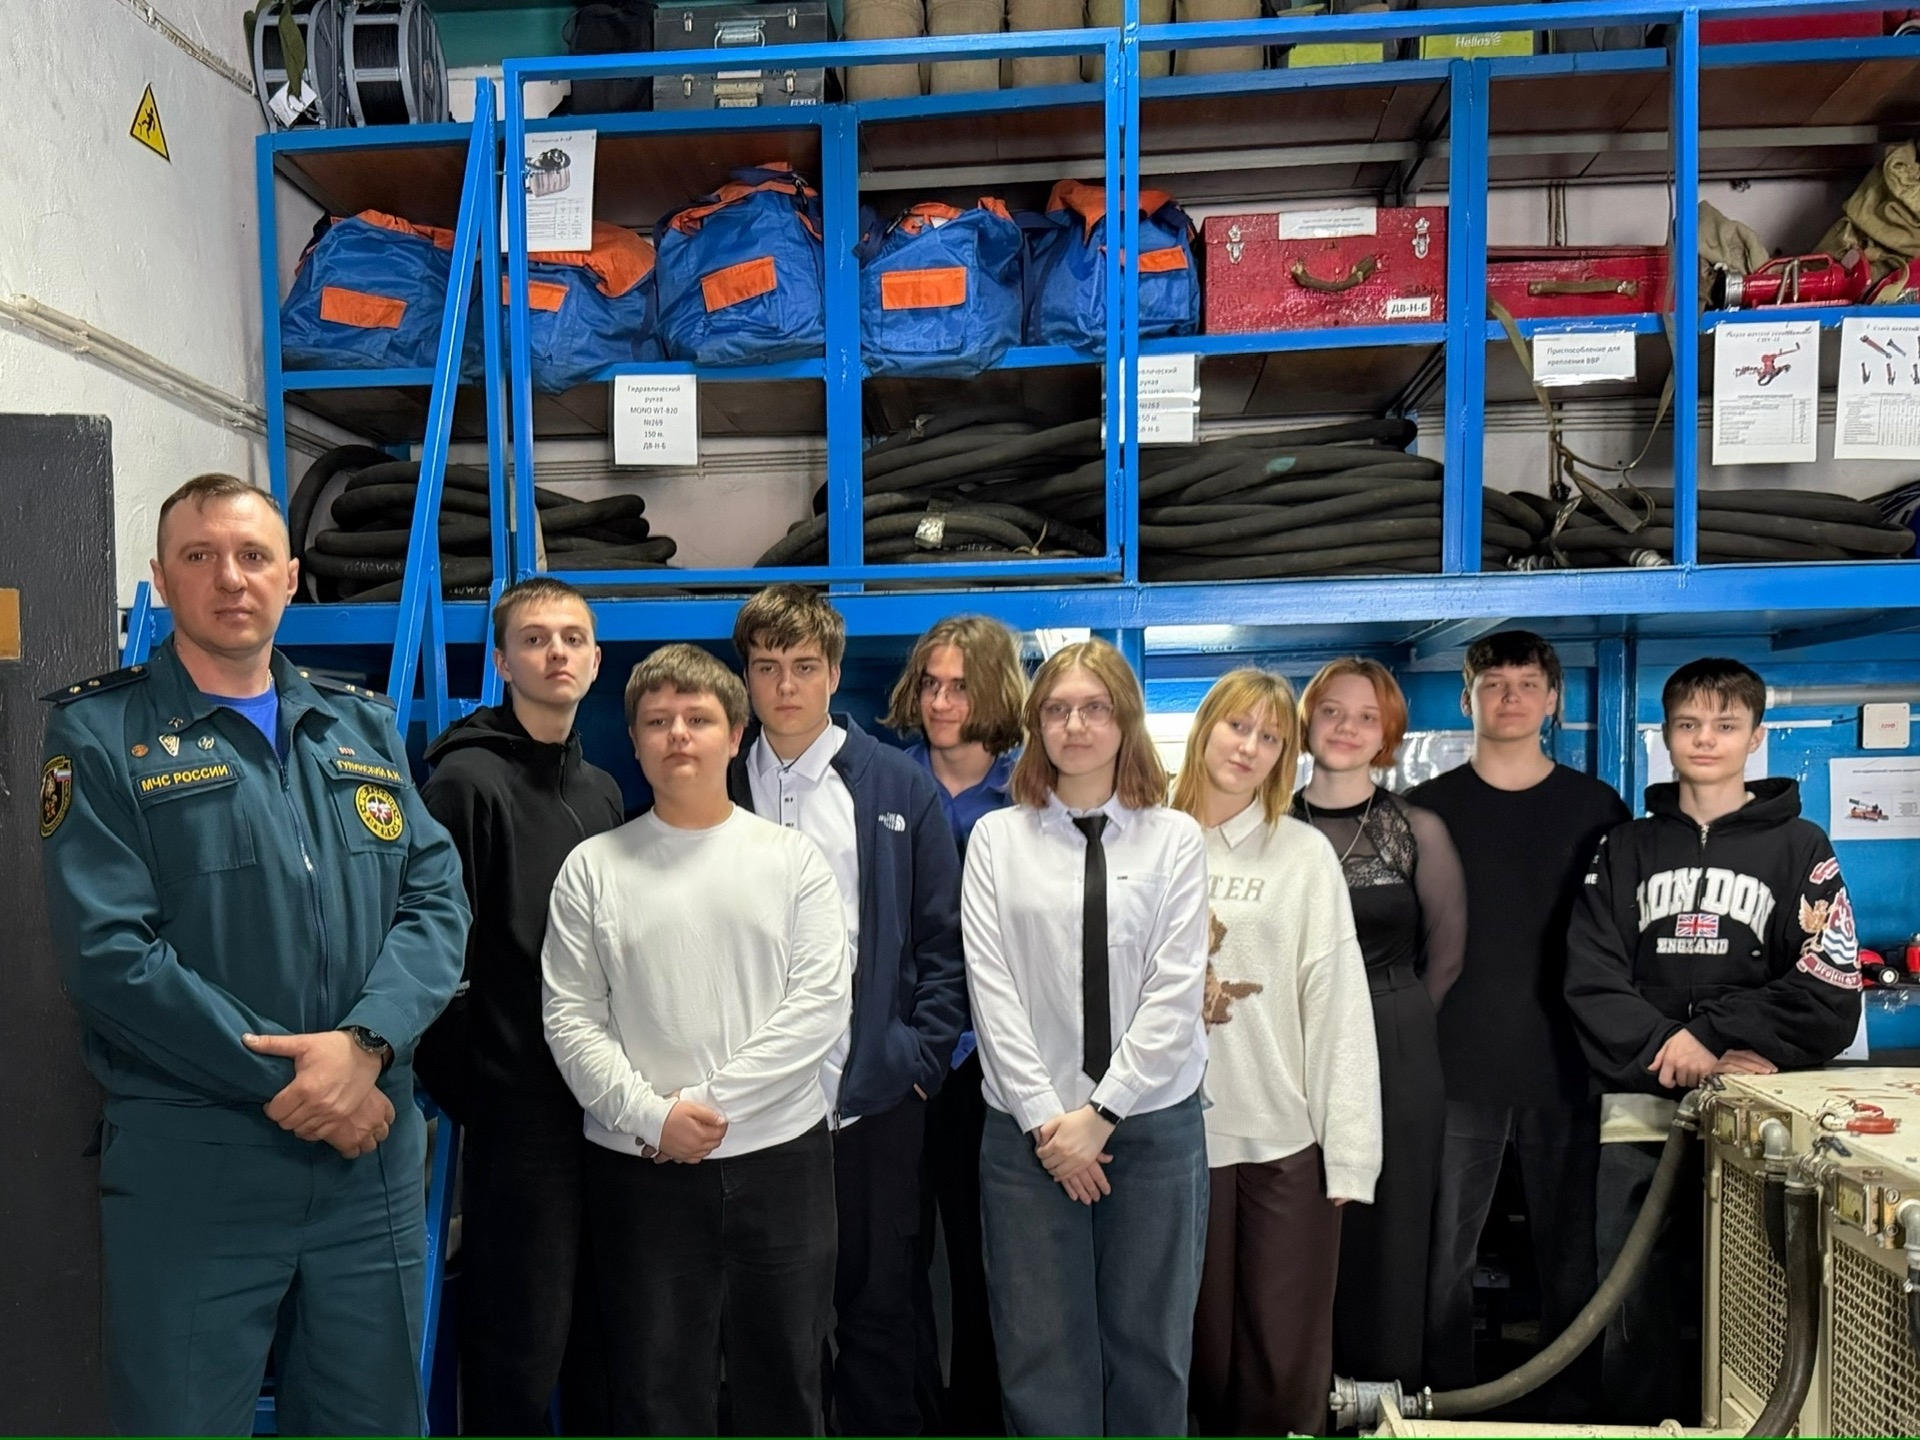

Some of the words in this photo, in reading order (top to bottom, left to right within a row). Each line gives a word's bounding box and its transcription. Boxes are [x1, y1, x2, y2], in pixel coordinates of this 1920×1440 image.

[1391, 302, 1428, 314] ДВ-Н-Б
[1547, 346, 1606, 355] Приспособление
[627, 385, 681, 393] Гидравлический
[643, 419, 664, 427] №269
[642, 442, 667, 450] ДВ-Н-Б
[141, 773, 171, 792] МЧС
[173, 764, 229, 785] РОССИИ
[1636, 867, 1776, 945] LONDON
[1656, 937, 1729, 955] ENGLAND
